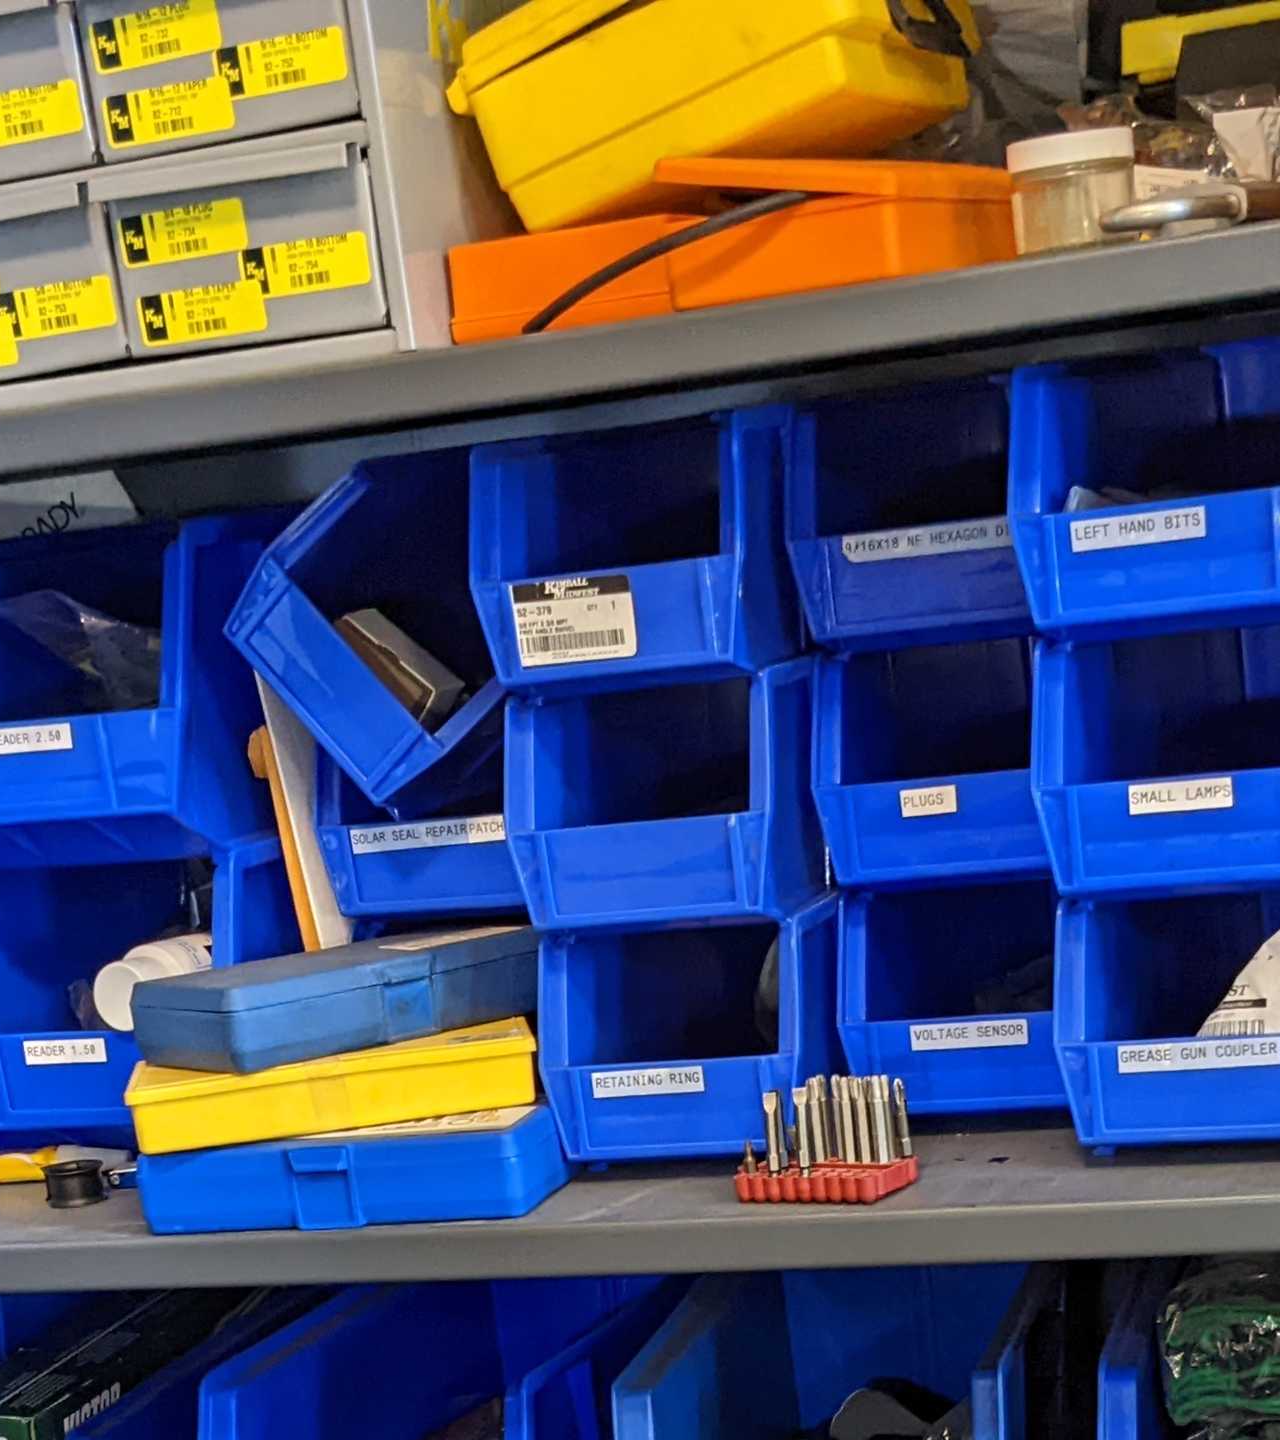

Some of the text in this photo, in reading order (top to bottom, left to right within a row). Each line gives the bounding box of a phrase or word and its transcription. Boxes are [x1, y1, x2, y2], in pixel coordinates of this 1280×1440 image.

[1075, 513, 1201, 541] LEFT HAND BITS
[930, 528, 987, 544] HEXAGON
[35, 730, 61, 744] 2.50
[903, 793, 944, 808] PLUGS
[1131, 785, 1232, 805] SMALL LAMPS
[353, 821, 503, 845] SOLAR SEAL REPAIR PATCH
[914, 1024, 1023, 1041] VOLTAGE SENSOR
[27, 1044, 95, 1056] READER 1.50
[1120, 1042, 1277, 1063] GREASE GUN COUPLER
[596, 1071, 700, 1088] RETAINING RING
